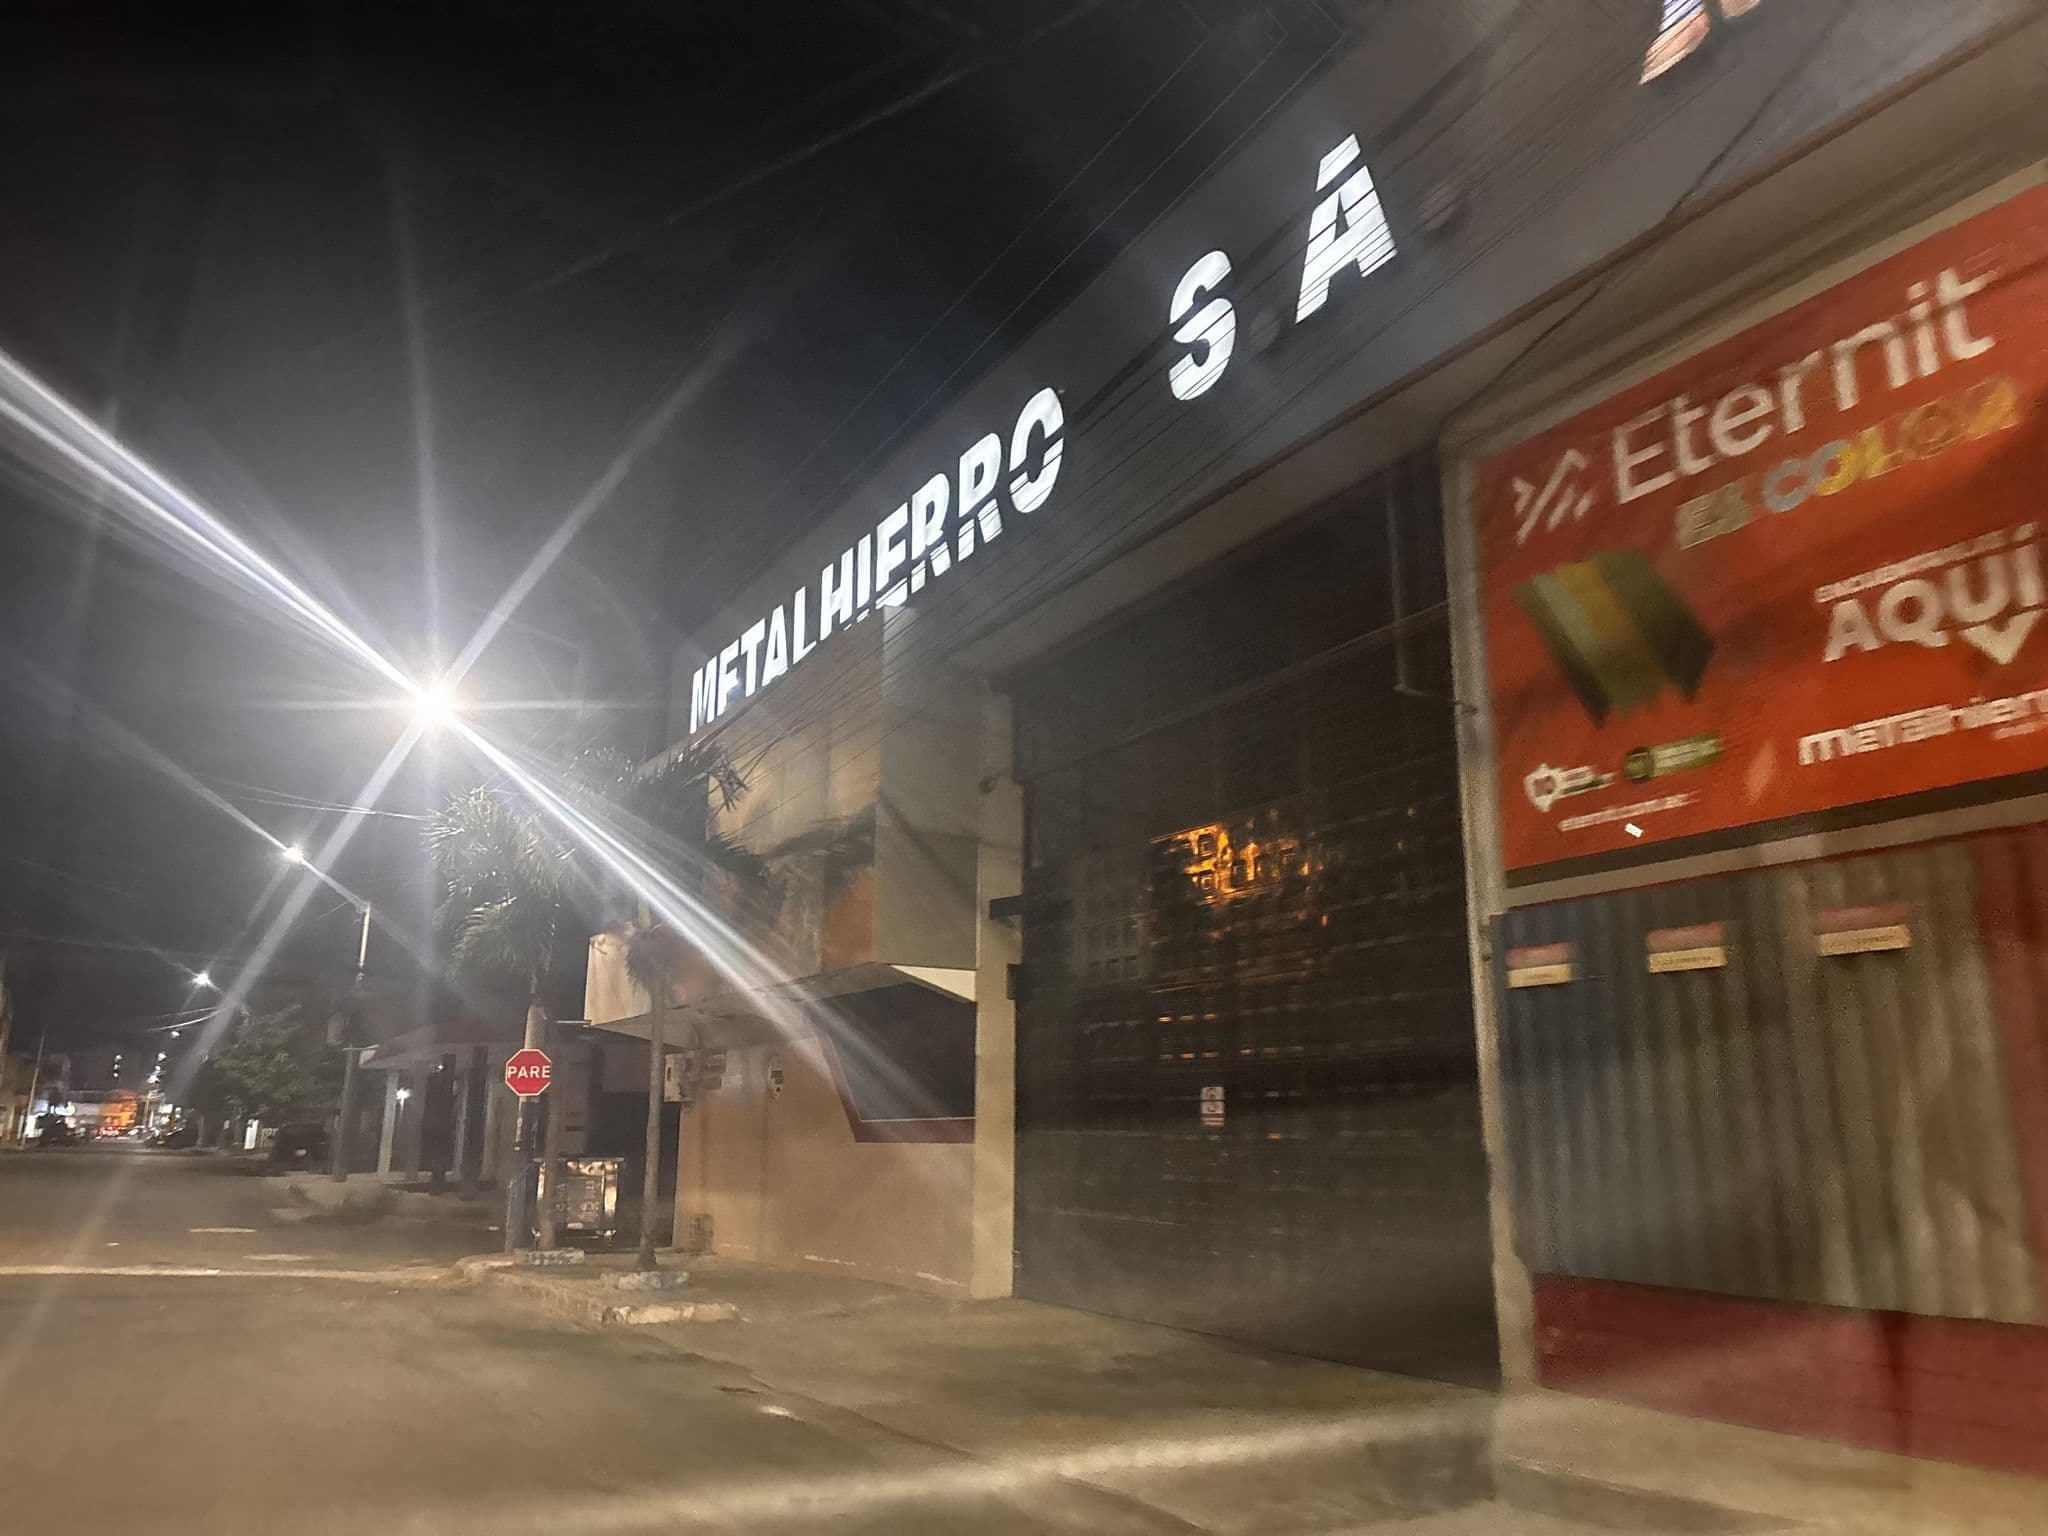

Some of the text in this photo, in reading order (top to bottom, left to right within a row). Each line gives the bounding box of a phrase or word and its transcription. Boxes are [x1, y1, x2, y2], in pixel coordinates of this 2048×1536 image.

[689, 133, 1398, 734] METALHIERRO S A
[1611, 267, 1998, 503] Eternit
[507, 1065, 551, 1079] PARE
